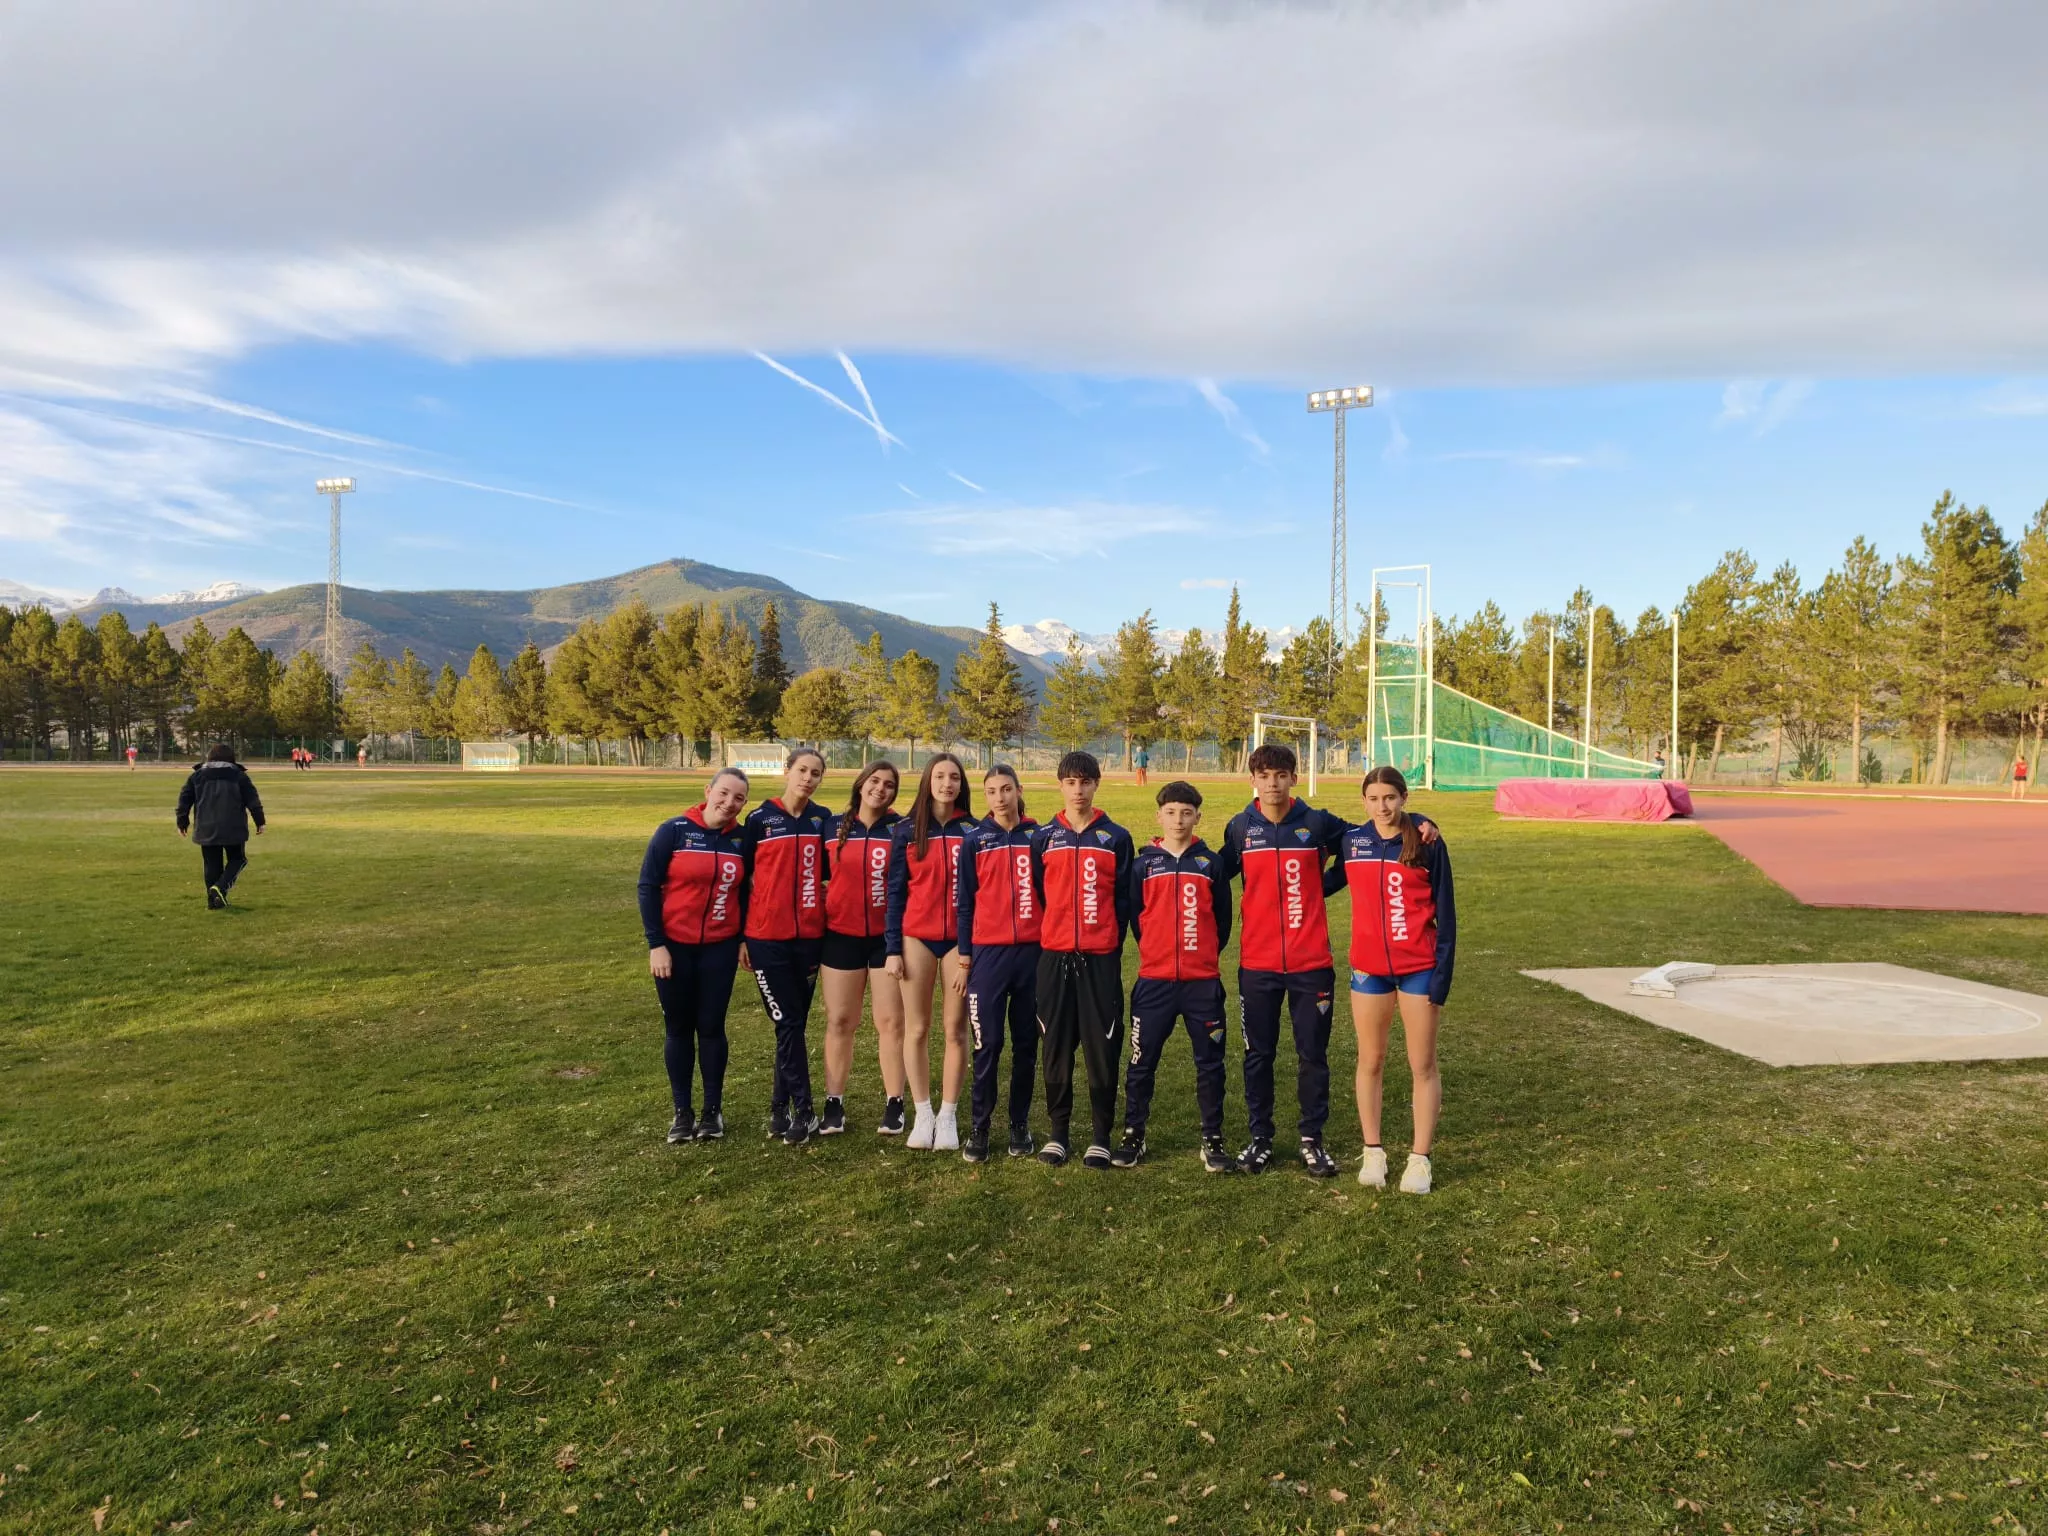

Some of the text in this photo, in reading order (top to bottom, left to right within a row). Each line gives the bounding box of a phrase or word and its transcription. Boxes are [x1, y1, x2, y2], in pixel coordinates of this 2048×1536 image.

[712, 861, 737, 921] HINACO
[803, 844, 816, 908] HINACO
[871, 847, 887, 907] HINACO
[1016, 854, 1033, 919] HINACO
[1083, 856, 1098, 924] HINACO
[1285, 858, 1304, 929] HINACO
[1387, 871, 1409, 942] HINACO
[1183, 882, 1198, 951] HINACO
[755, 969, 783, 1021] HINACO
